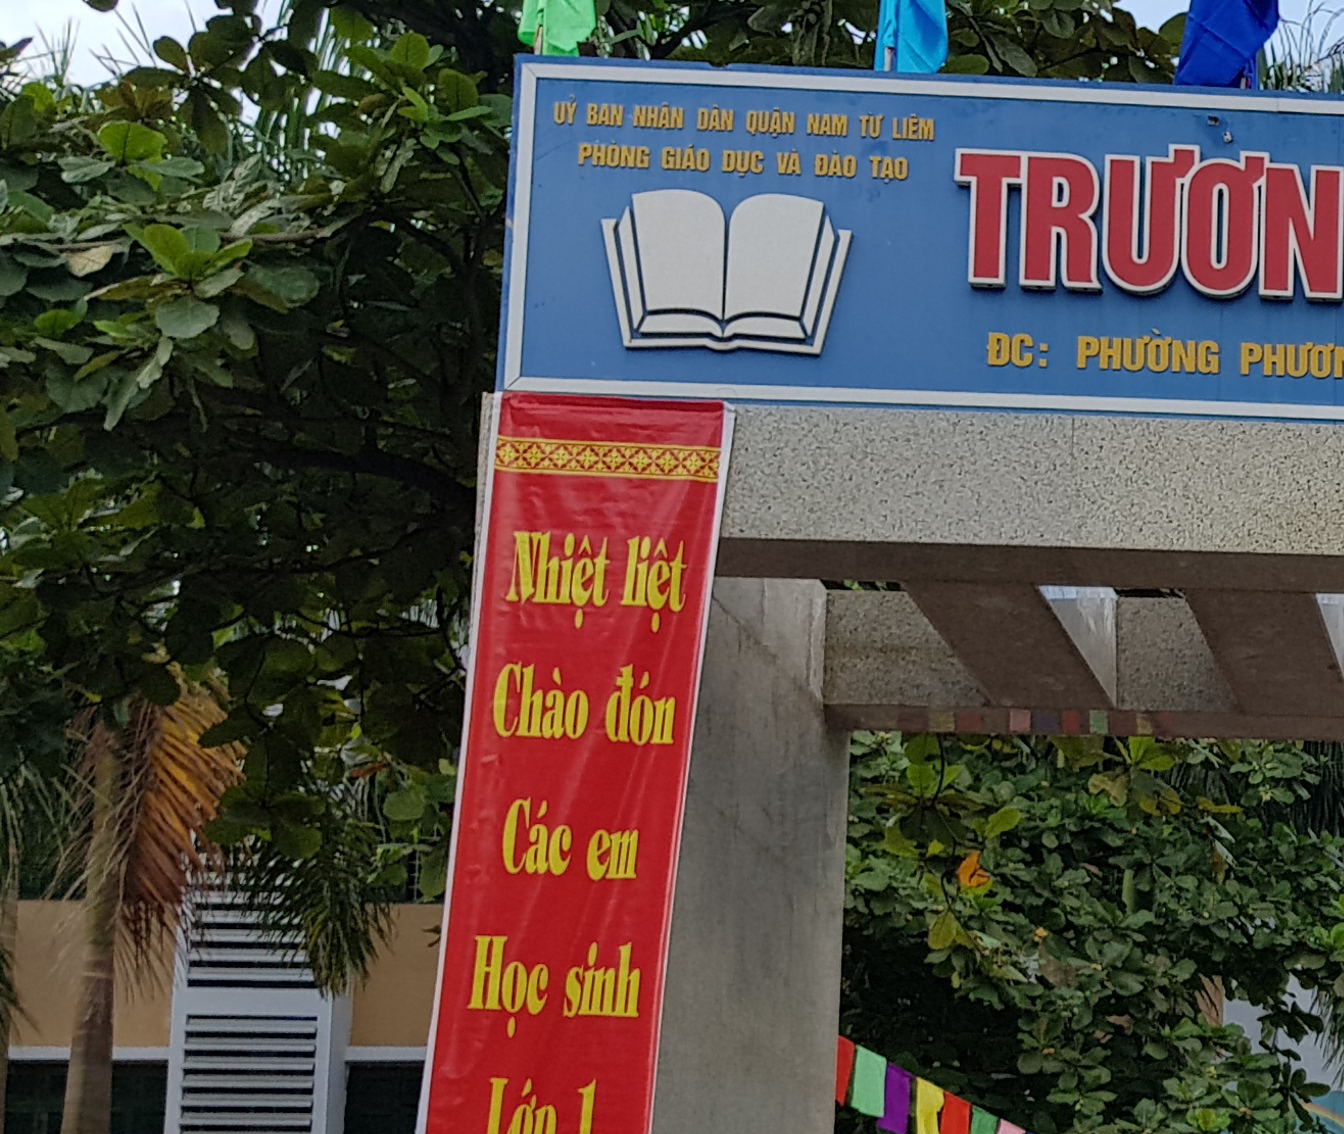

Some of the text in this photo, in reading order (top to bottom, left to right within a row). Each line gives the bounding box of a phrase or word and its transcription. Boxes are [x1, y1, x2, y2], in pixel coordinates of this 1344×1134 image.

[577, 140, 909, 184] PHÒNG GIÁO DỤC VÀ ĐÀO TẠO
[587, 103, 624, 127] BAN
[632, 101, 684, 130] NHÂN
[697, 104, 735, 132] DÂN
[745, 107, 796, 138] QUẬN
[807, 114, 848, 138] NAM
[860, 111, 885, 139] TỪ
[892, 113, 935, 141] LIÊM
[987, 332, 1049, 369] ĐC:
[1076, 327, 1219, 375] PHƯỜNG
[506, 531, 687, 633] Nhiệt liệt
[493, 661, 676, 746] Chào đón
[502, 796, 640, 881] Các em
[466, 936, 640, 1038] Học sinh
